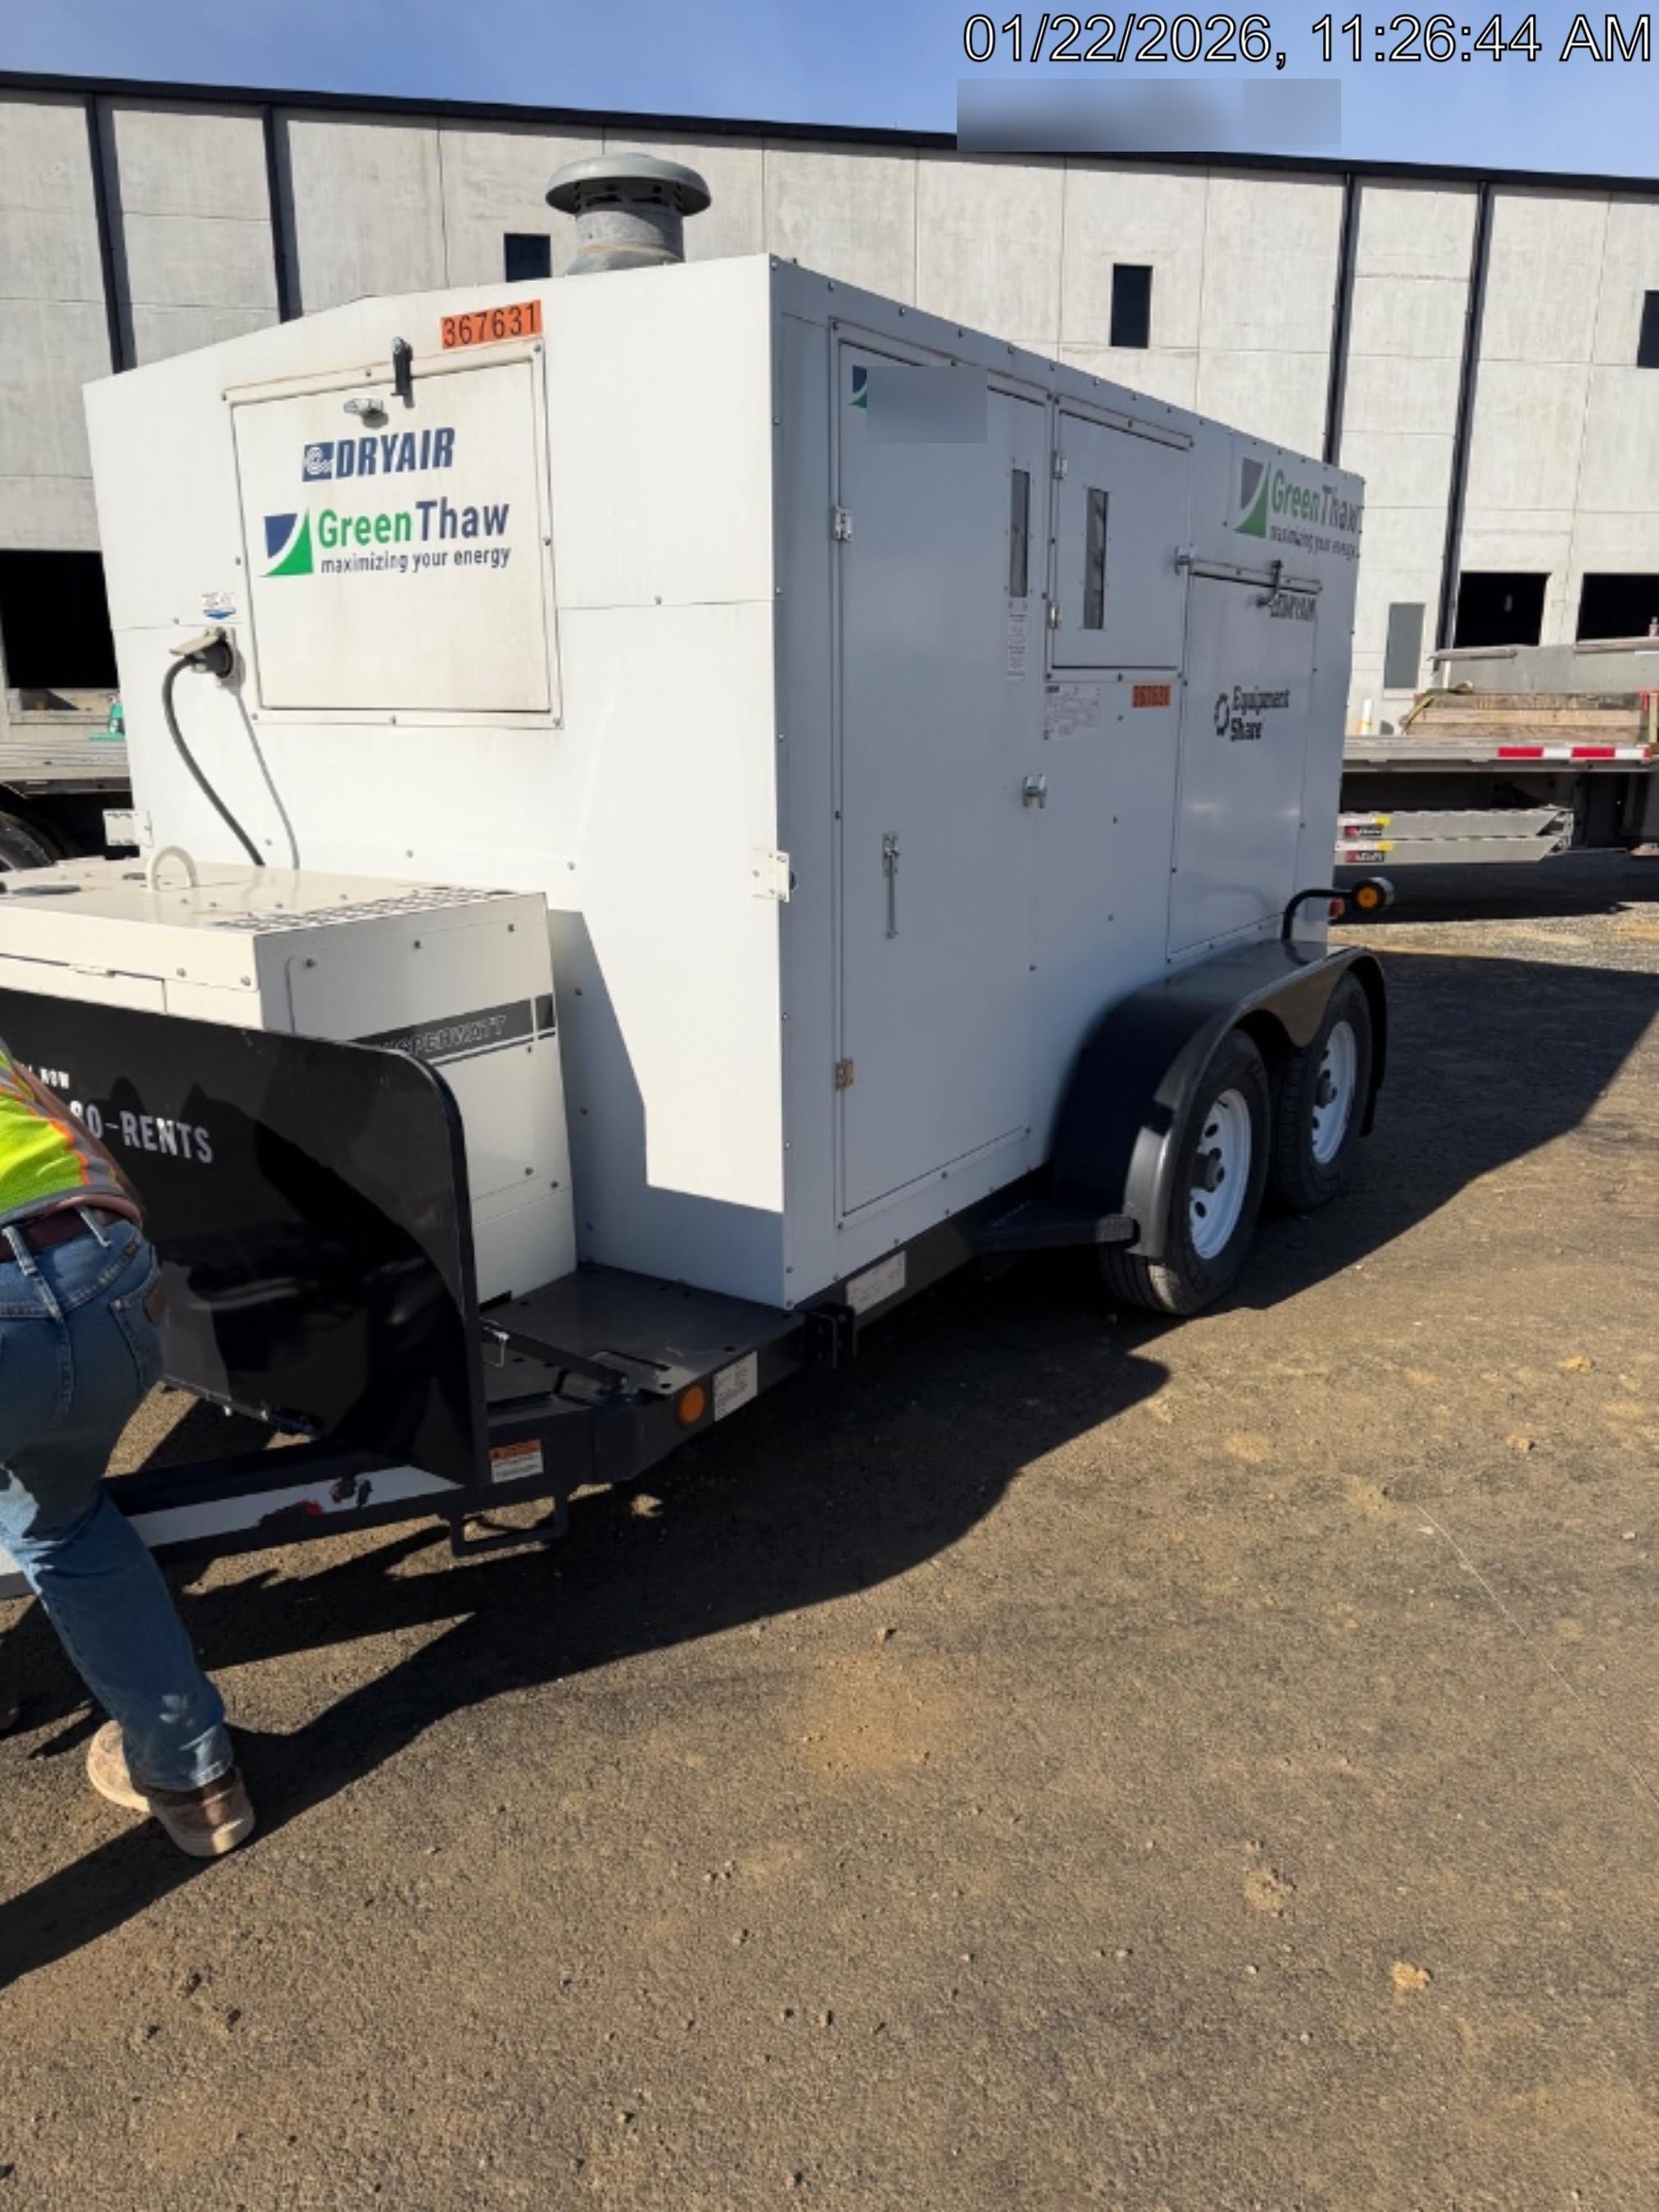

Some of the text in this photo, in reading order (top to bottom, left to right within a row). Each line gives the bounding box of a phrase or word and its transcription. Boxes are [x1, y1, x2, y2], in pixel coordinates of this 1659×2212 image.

[443, 303, 537, 347] 367631
[336, 427, 456, 478] DRYAIR
[321, 546, 511, 573] maximizing your energy
[1232, 686, 1290, 715] Equipment
[1231, 717, 1262, 742] Share
